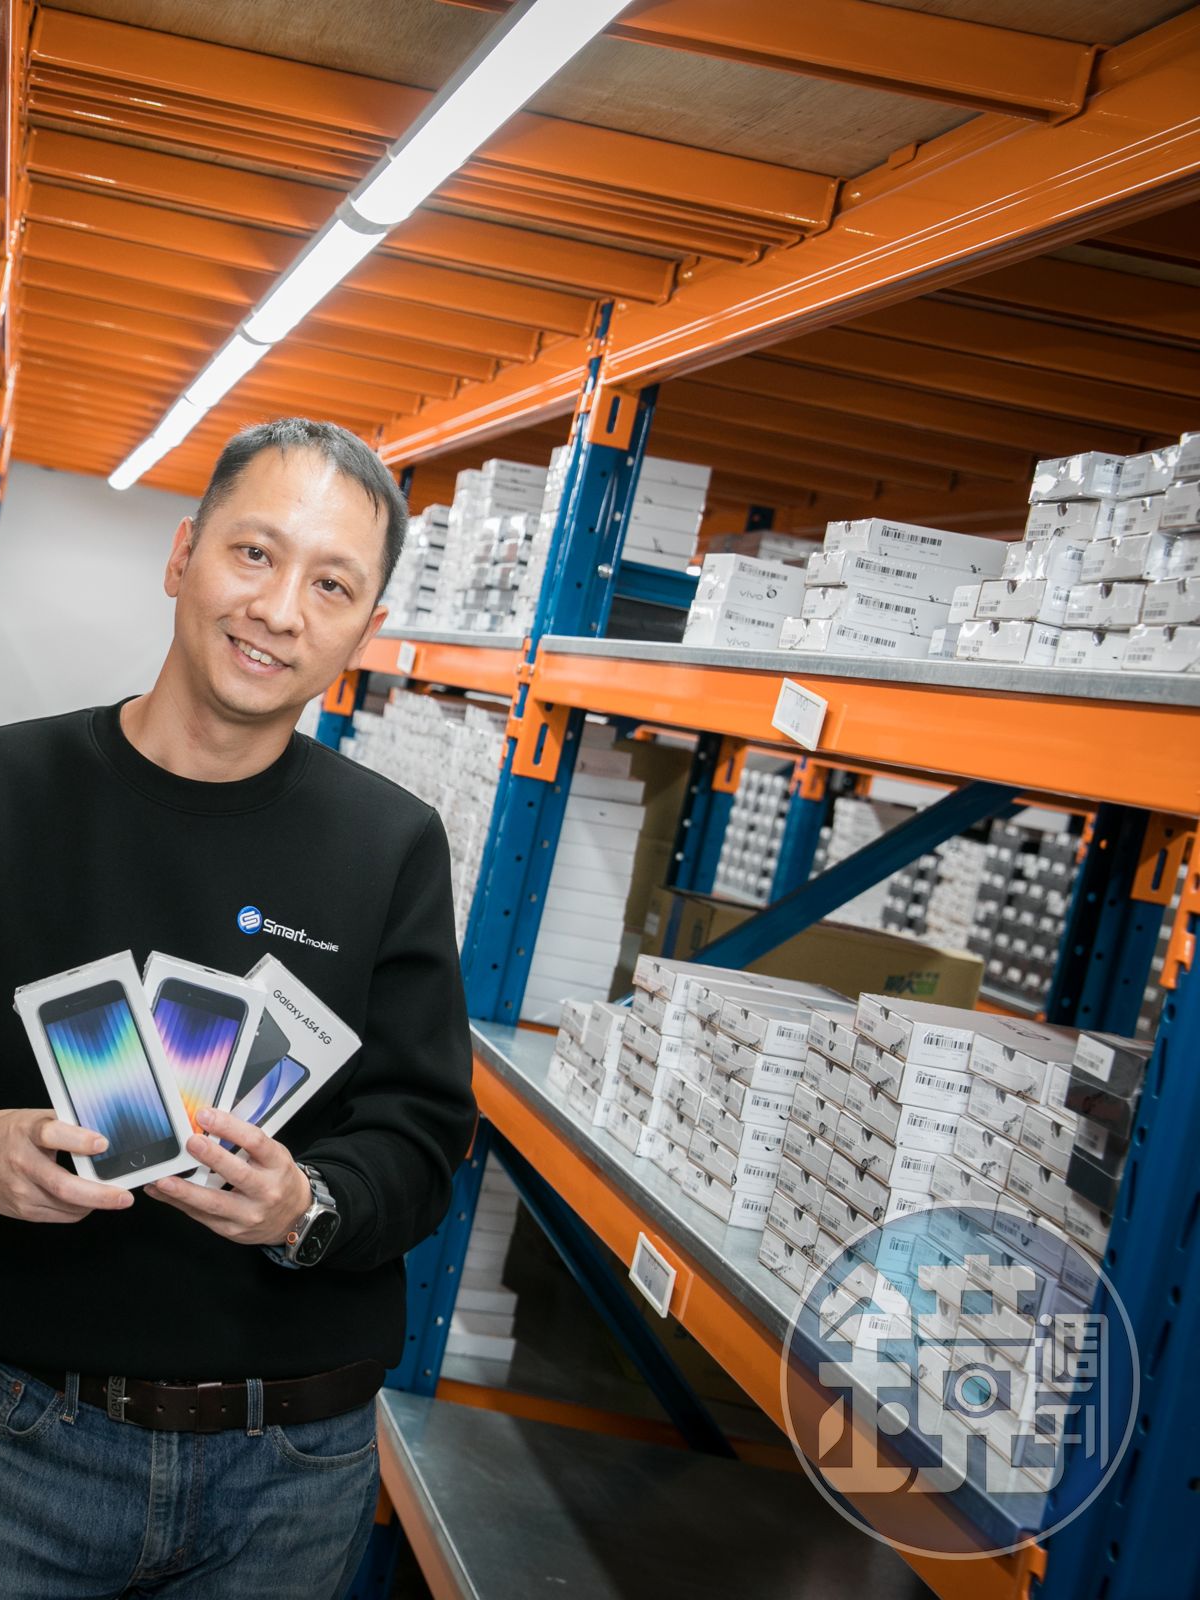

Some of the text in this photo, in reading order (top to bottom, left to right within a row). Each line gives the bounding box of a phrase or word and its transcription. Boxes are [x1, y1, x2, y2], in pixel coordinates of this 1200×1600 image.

[739, 590, 764, 601] vivo
[263, 919, 307, 943] Smart
[305, 938, 339, 952] mobile
[273, 989, 332, 1045] Galaxy A54 5G
